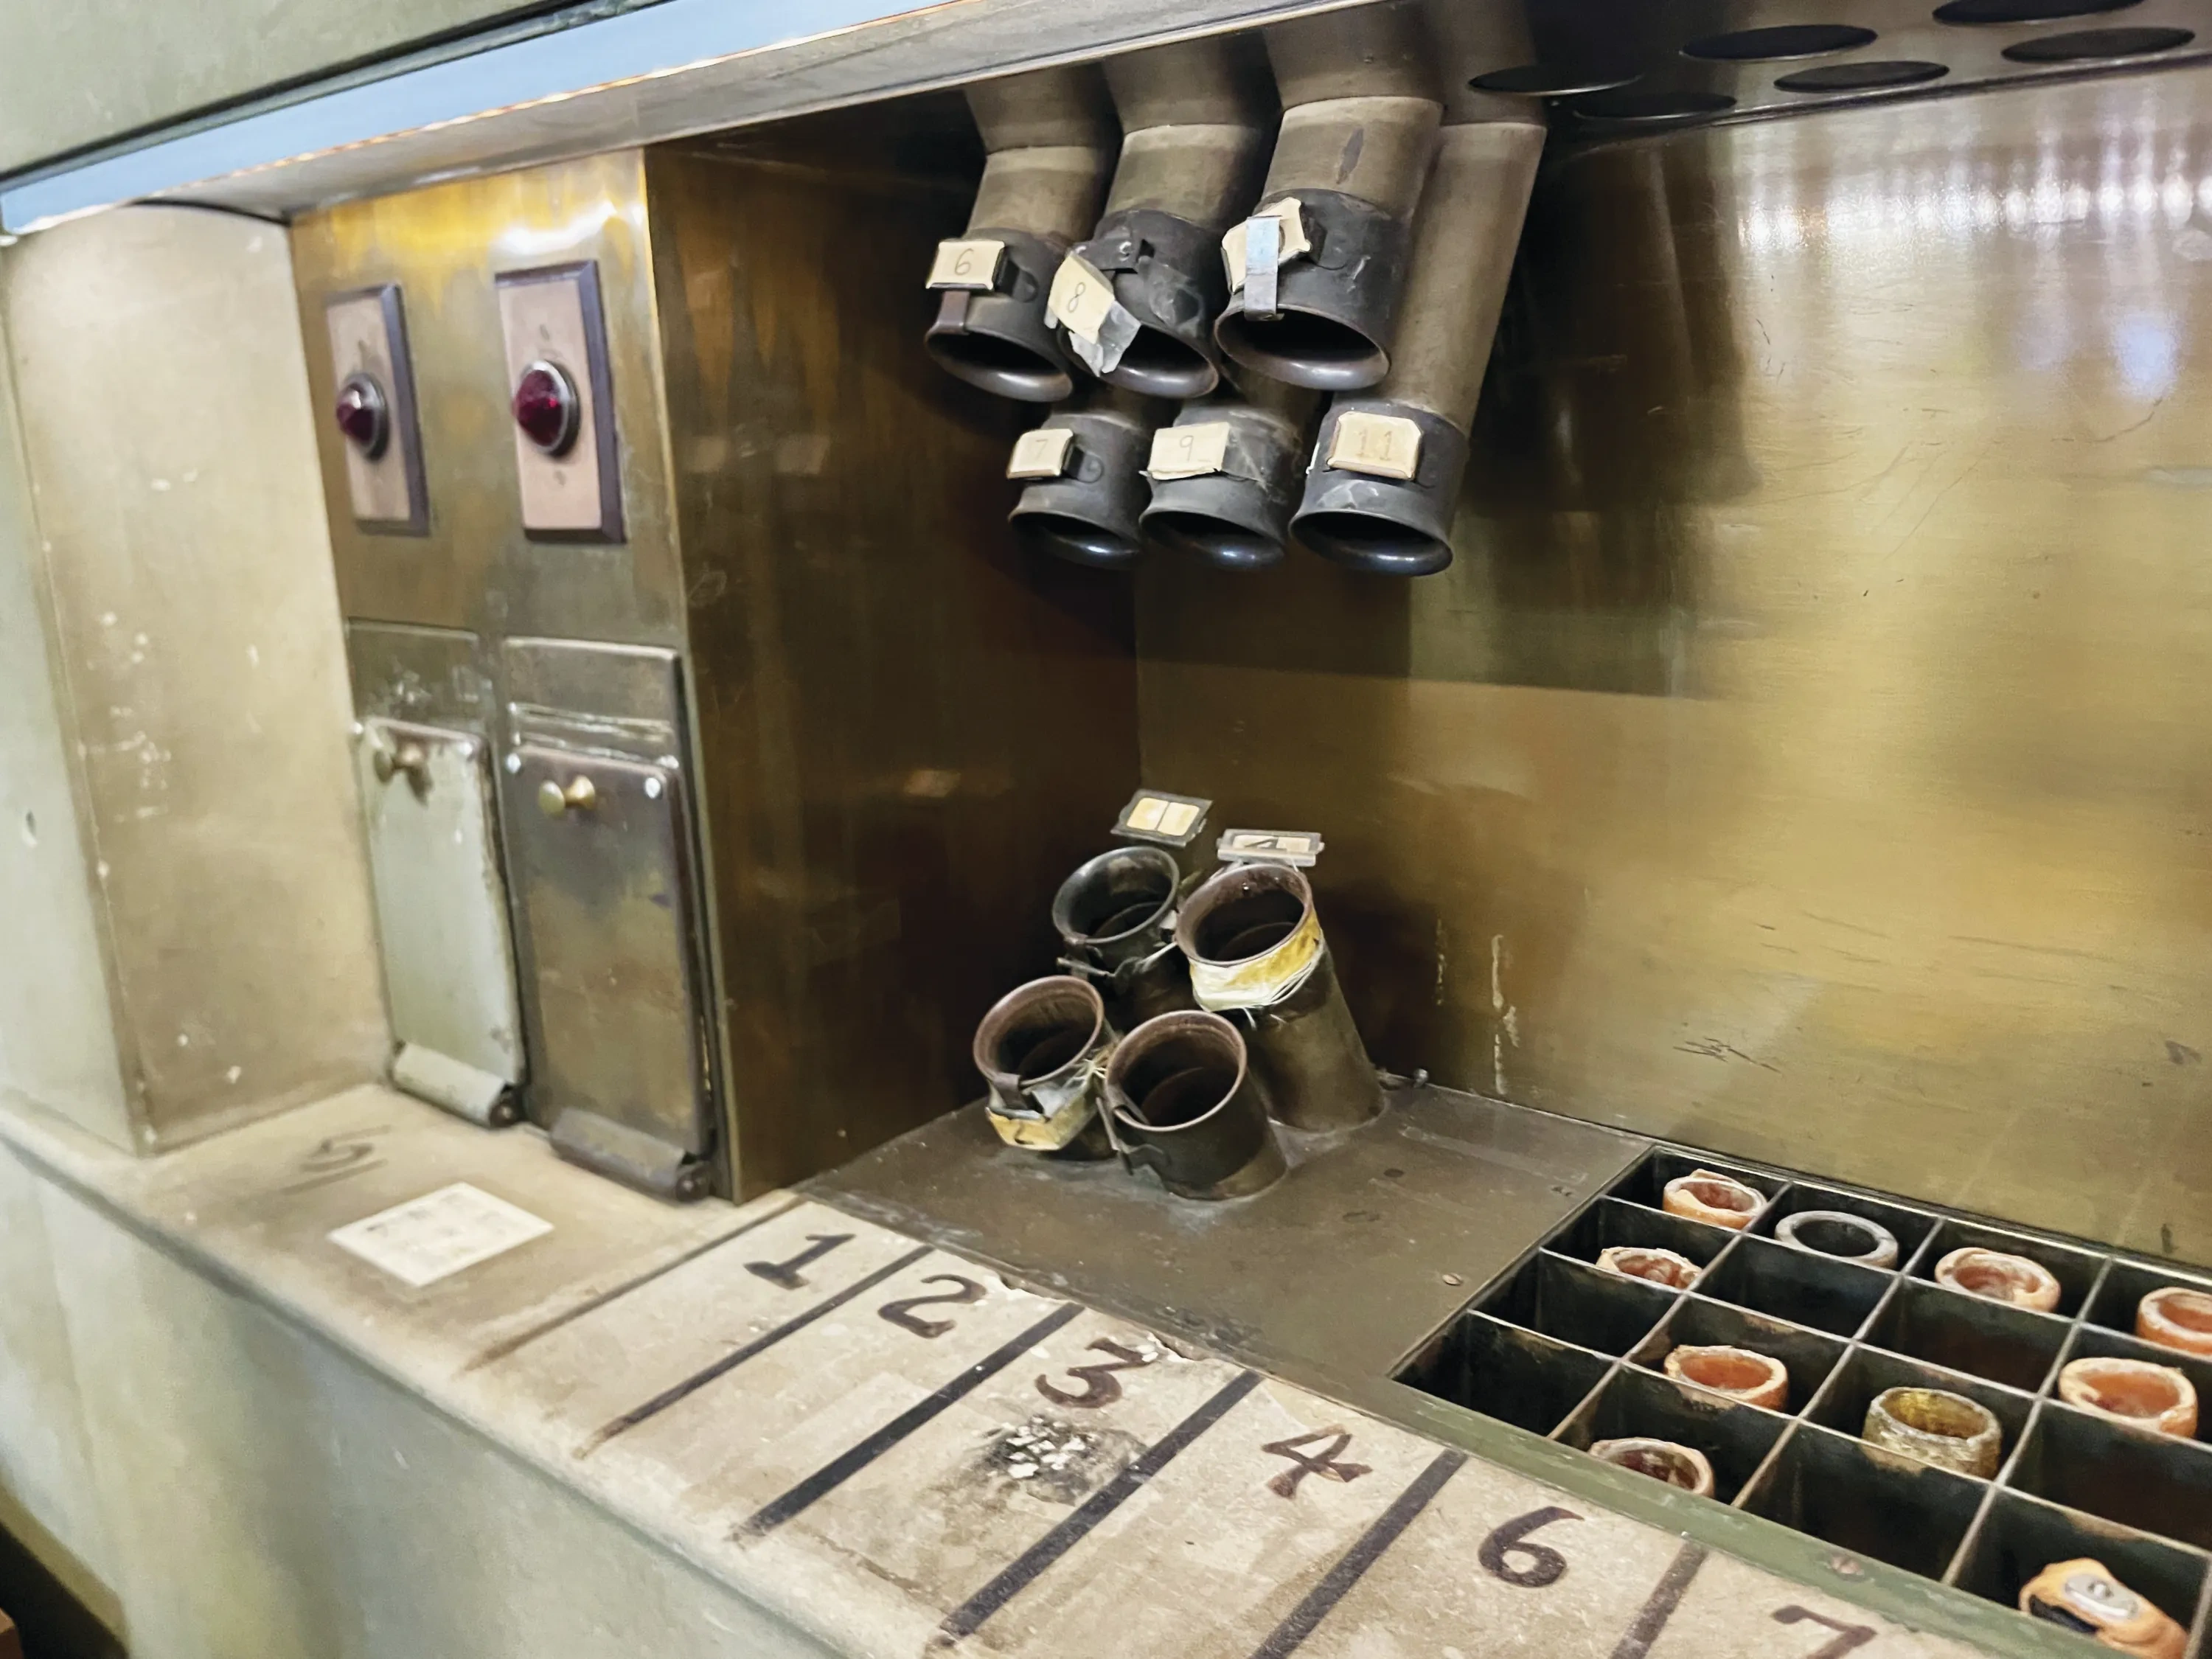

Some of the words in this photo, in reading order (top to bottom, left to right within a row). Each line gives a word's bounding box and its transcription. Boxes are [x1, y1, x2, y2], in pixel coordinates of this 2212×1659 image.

[954, 248, 974, 276] 6
[1067, 282, 1086, 313] 8
[1035, 438, 1048, 461] 7
[1180, 434, 1194, 462] 9
[1355, 428, 1393, 462] 11
[743, 1232, 856, 1290] 1
[877, 1273, 987, 1339] 2
[1035, 1336, 1152, 1409] 3
[1262, 1422, 1374, 1500] 4
[1478, 1505, 1585, 1588] 6
[1770, 1604, 1878, 1659] 7
